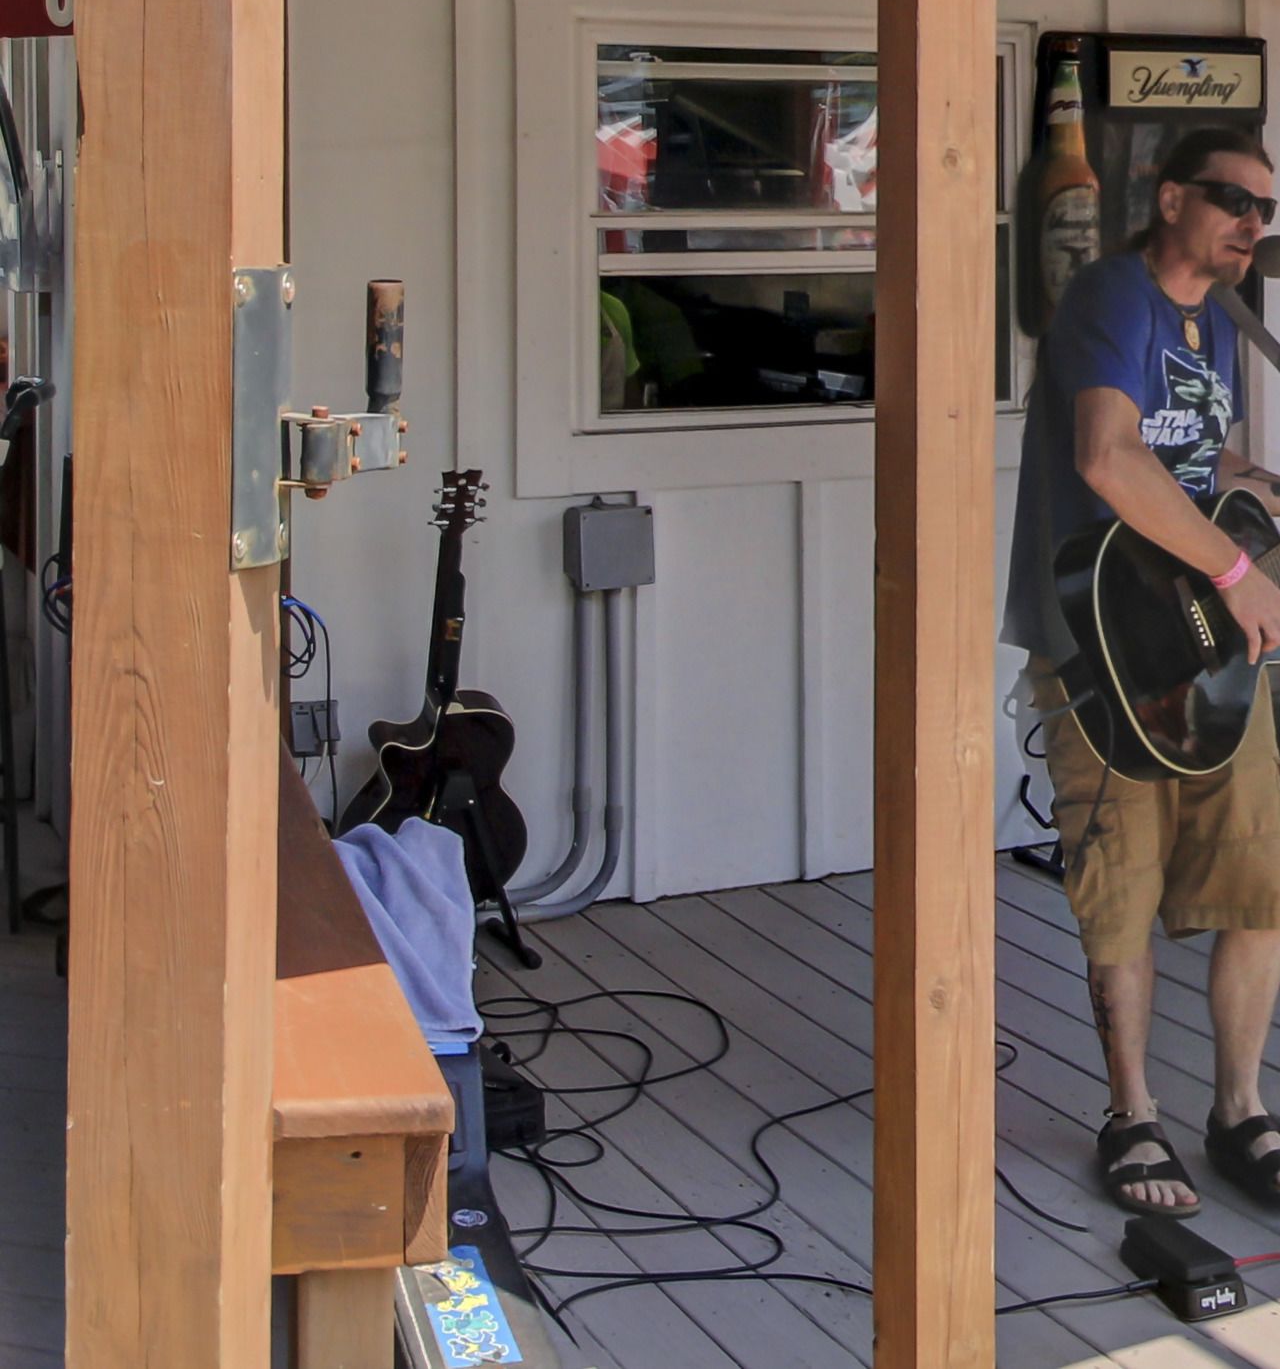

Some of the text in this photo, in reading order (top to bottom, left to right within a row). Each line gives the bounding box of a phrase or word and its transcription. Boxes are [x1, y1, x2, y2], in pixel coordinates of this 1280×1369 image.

[1127, 66, 1242, 105] Yuengling
[1142, 409, 1203, 429] STAR
[1142, 426, 1202, 446] WARS
